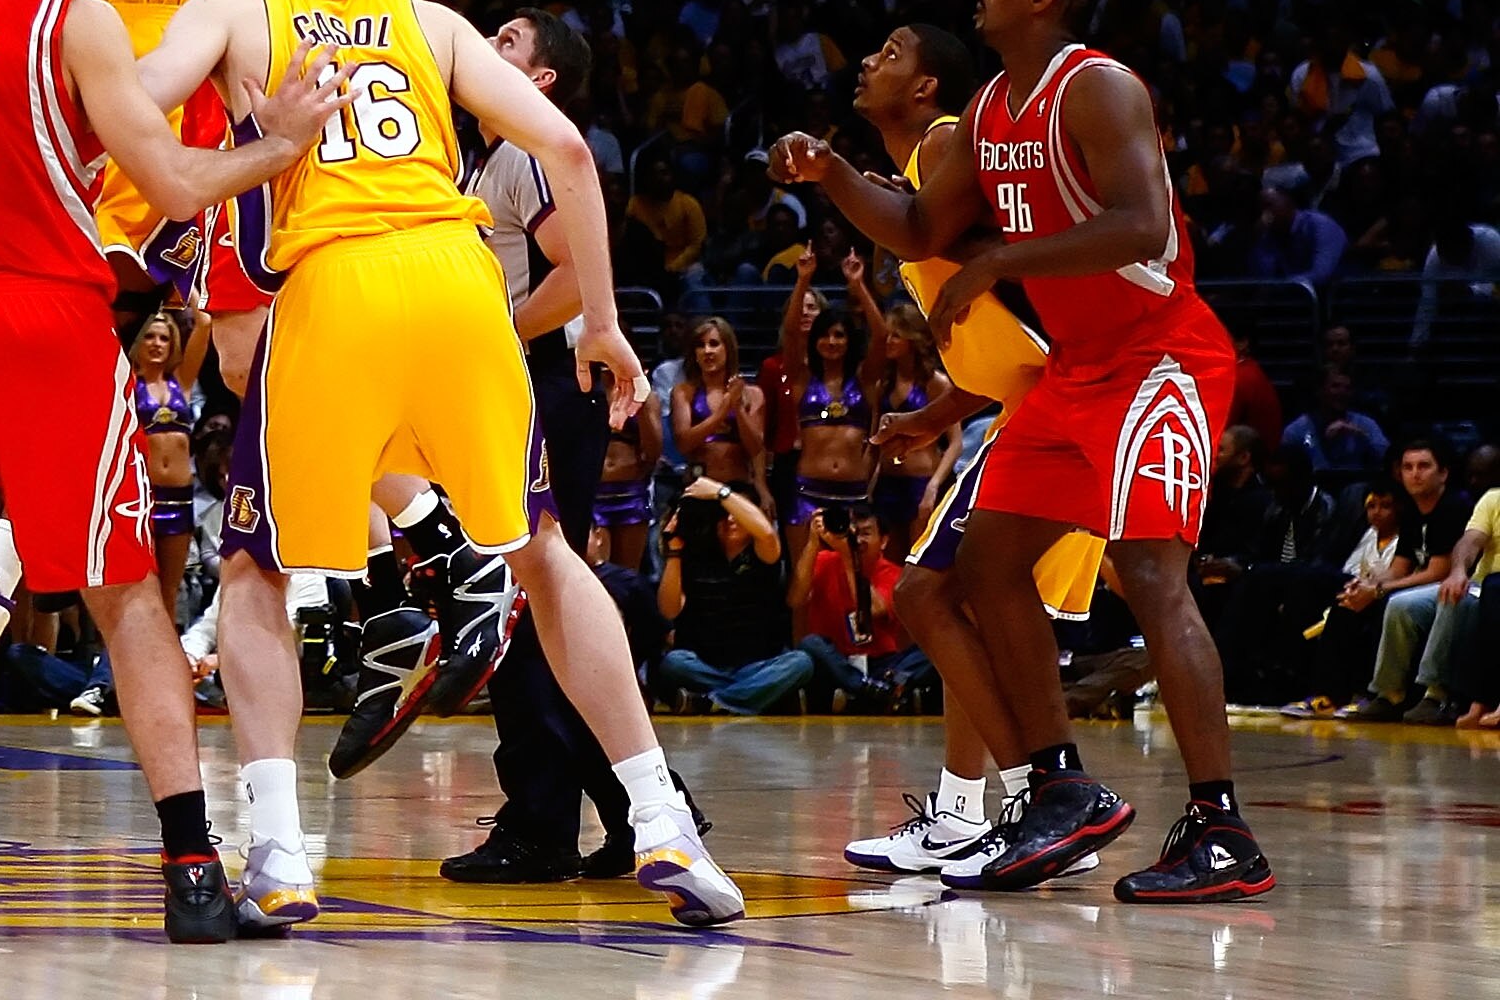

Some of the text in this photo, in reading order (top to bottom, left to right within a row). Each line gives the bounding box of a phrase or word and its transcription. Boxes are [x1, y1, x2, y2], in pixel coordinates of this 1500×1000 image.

[291, 9, 392, 49] GASOL
[315, 59, 422, 165] 16
[996, 182, 1035, 233] 96
